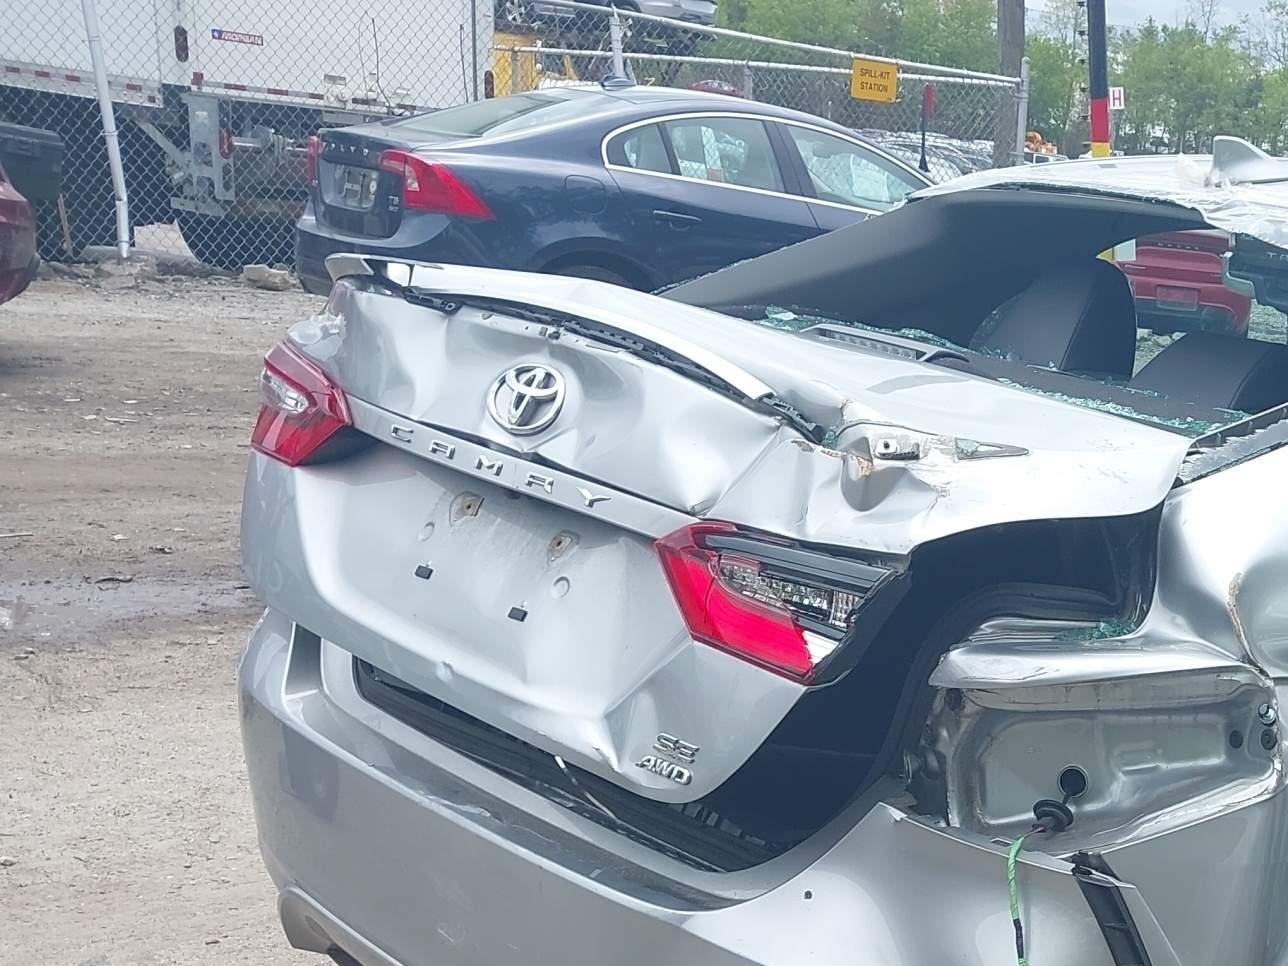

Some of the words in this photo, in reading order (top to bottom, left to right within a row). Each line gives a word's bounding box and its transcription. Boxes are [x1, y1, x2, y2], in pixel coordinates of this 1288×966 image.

[860, 68, 891, 81] SPILL-KIT
[860, 81, 888, 93] STATION
[1113, 89, 1122, 107] H
[391, 424, 611, 508] CAMRY
[652, 732, 700, 764] SE
[635, 755, 693, 786] AWD
